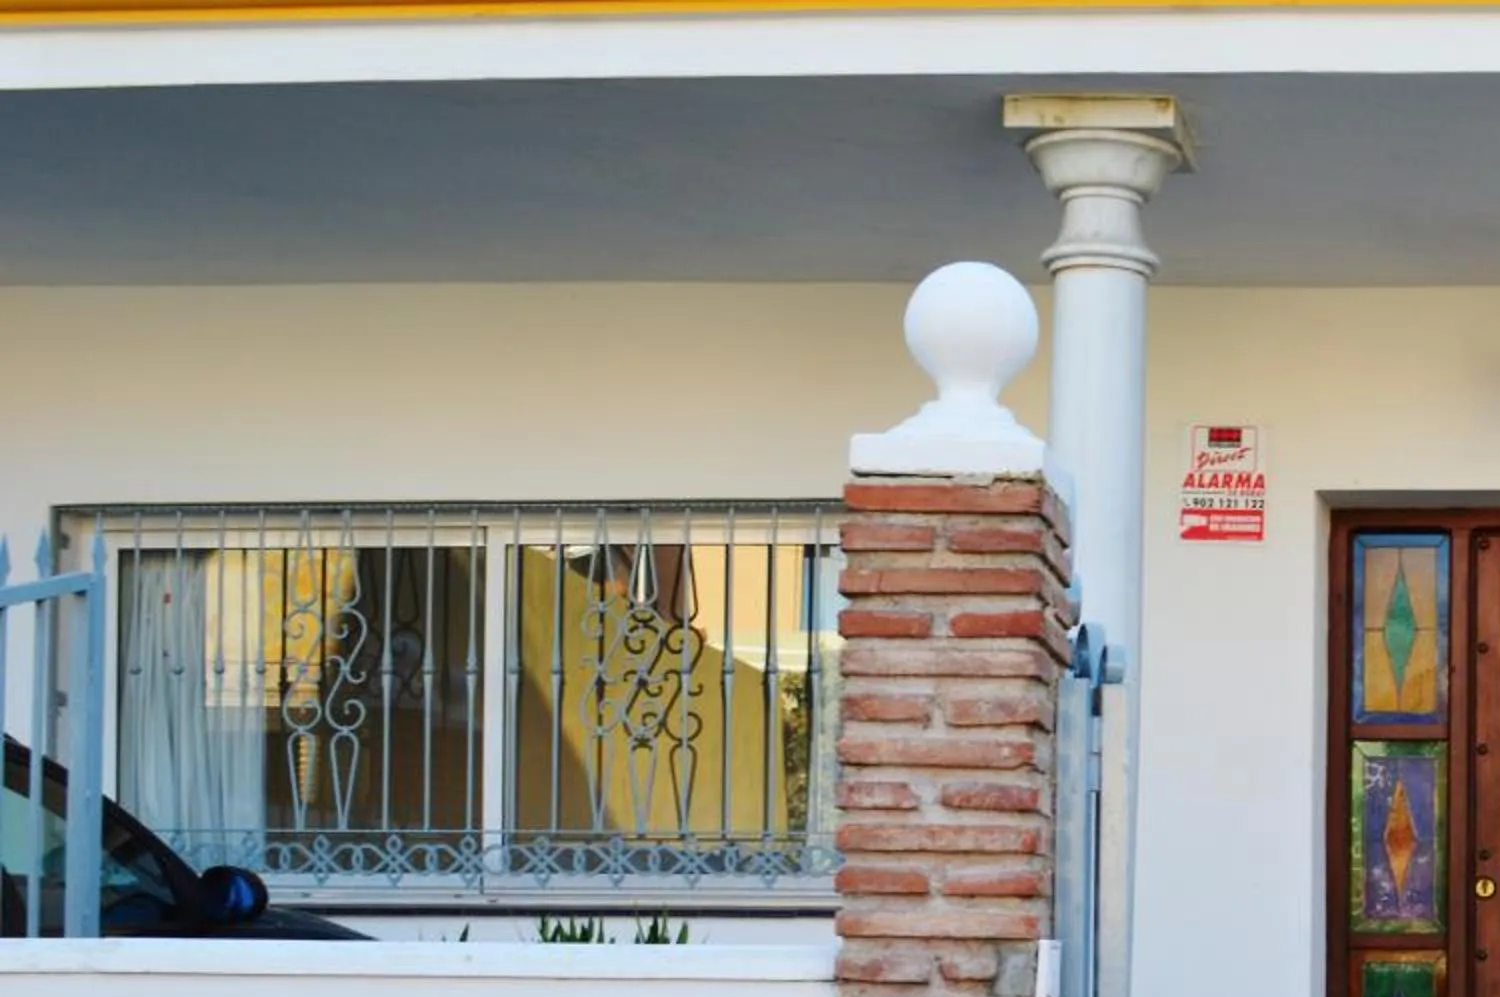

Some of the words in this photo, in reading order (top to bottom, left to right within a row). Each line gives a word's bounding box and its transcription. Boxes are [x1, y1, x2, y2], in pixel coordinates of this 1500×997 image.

[1183, 473, 1265, 489] ALARMA
[1192, 497, 1215, 508] 902
[1219, 498, 1239, 508] 121
[1245, 499, 1265, 508] 122
